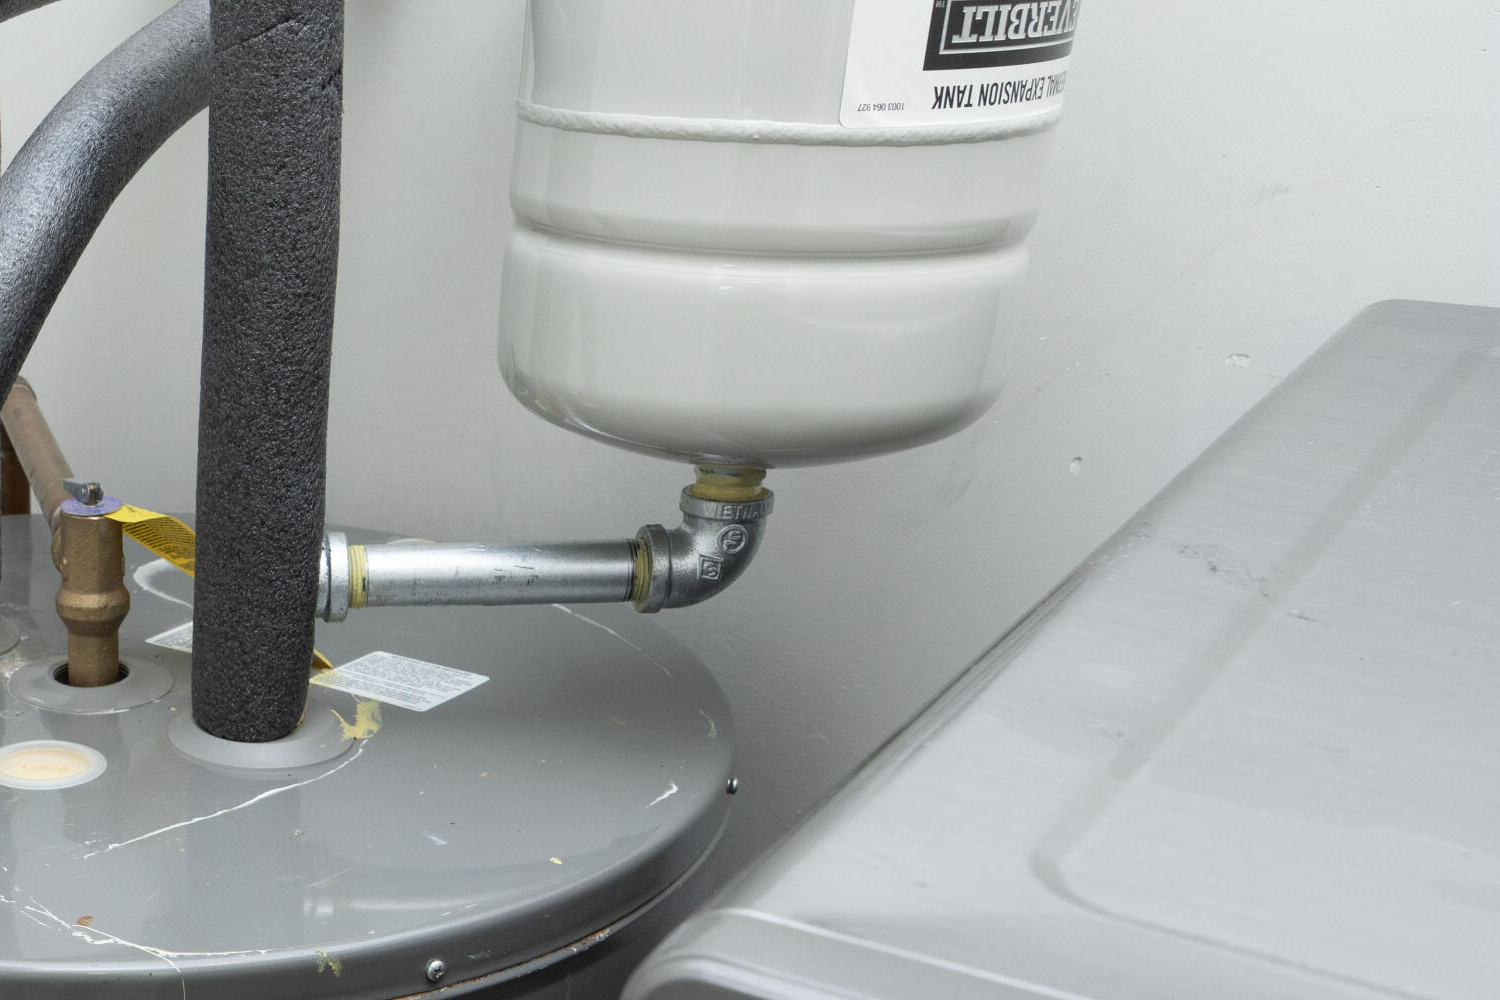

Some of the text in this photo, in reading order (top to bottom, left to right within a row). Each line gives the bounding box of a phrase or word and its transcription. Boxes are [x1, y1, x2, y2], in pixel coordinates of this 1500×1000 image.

[932, 83, 973, 109] TANK
[978, 75, 1045, 107] EXPANSION
[857, 101, 904, 112] 1003 064 927
